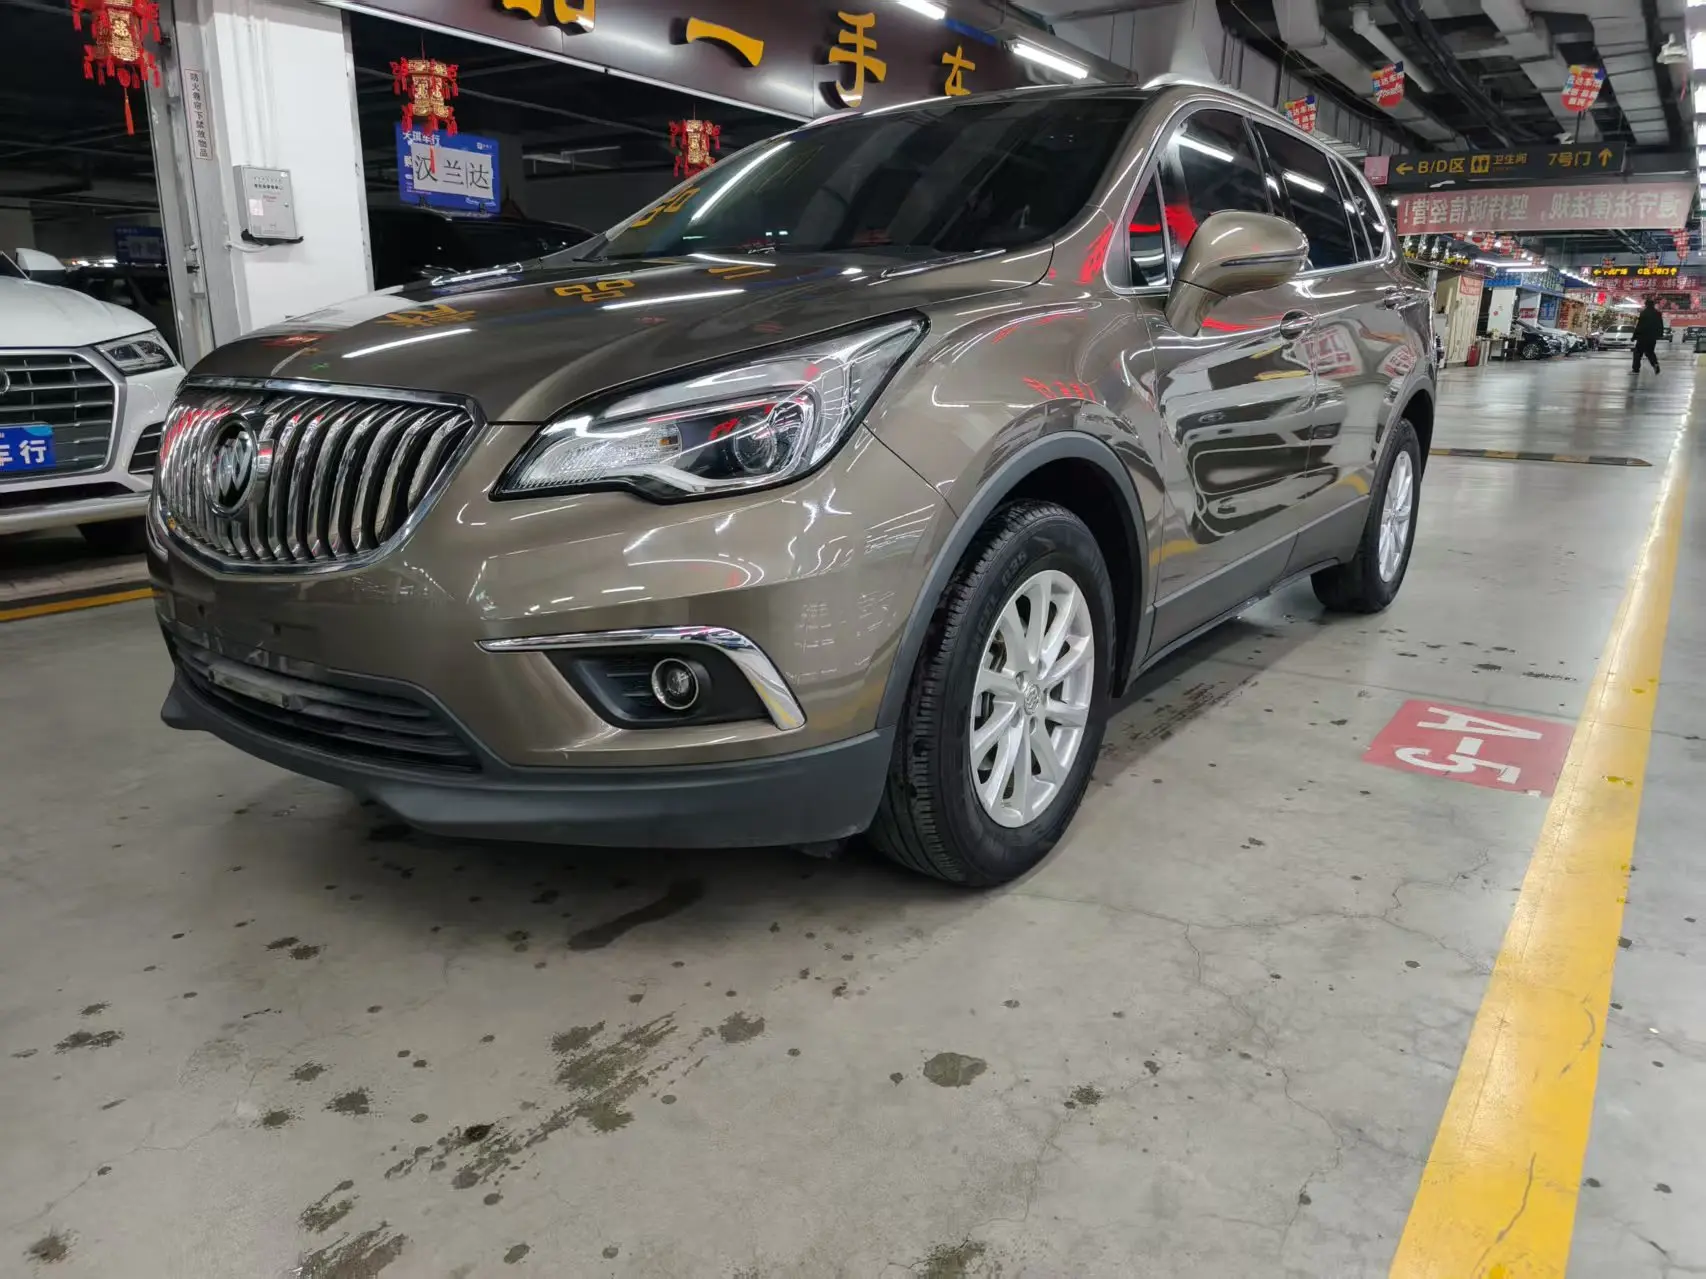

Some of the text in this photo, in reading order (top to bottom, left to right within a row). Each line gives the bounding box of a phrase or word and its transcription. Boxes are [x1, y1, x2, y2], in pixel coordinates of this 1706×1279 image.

[414, 154, 491, 190] 汉兰达
[1417, 151, 1591, 174] B/D区 卫生间 7号门
[1394, 706, 1544, 785] A-5
